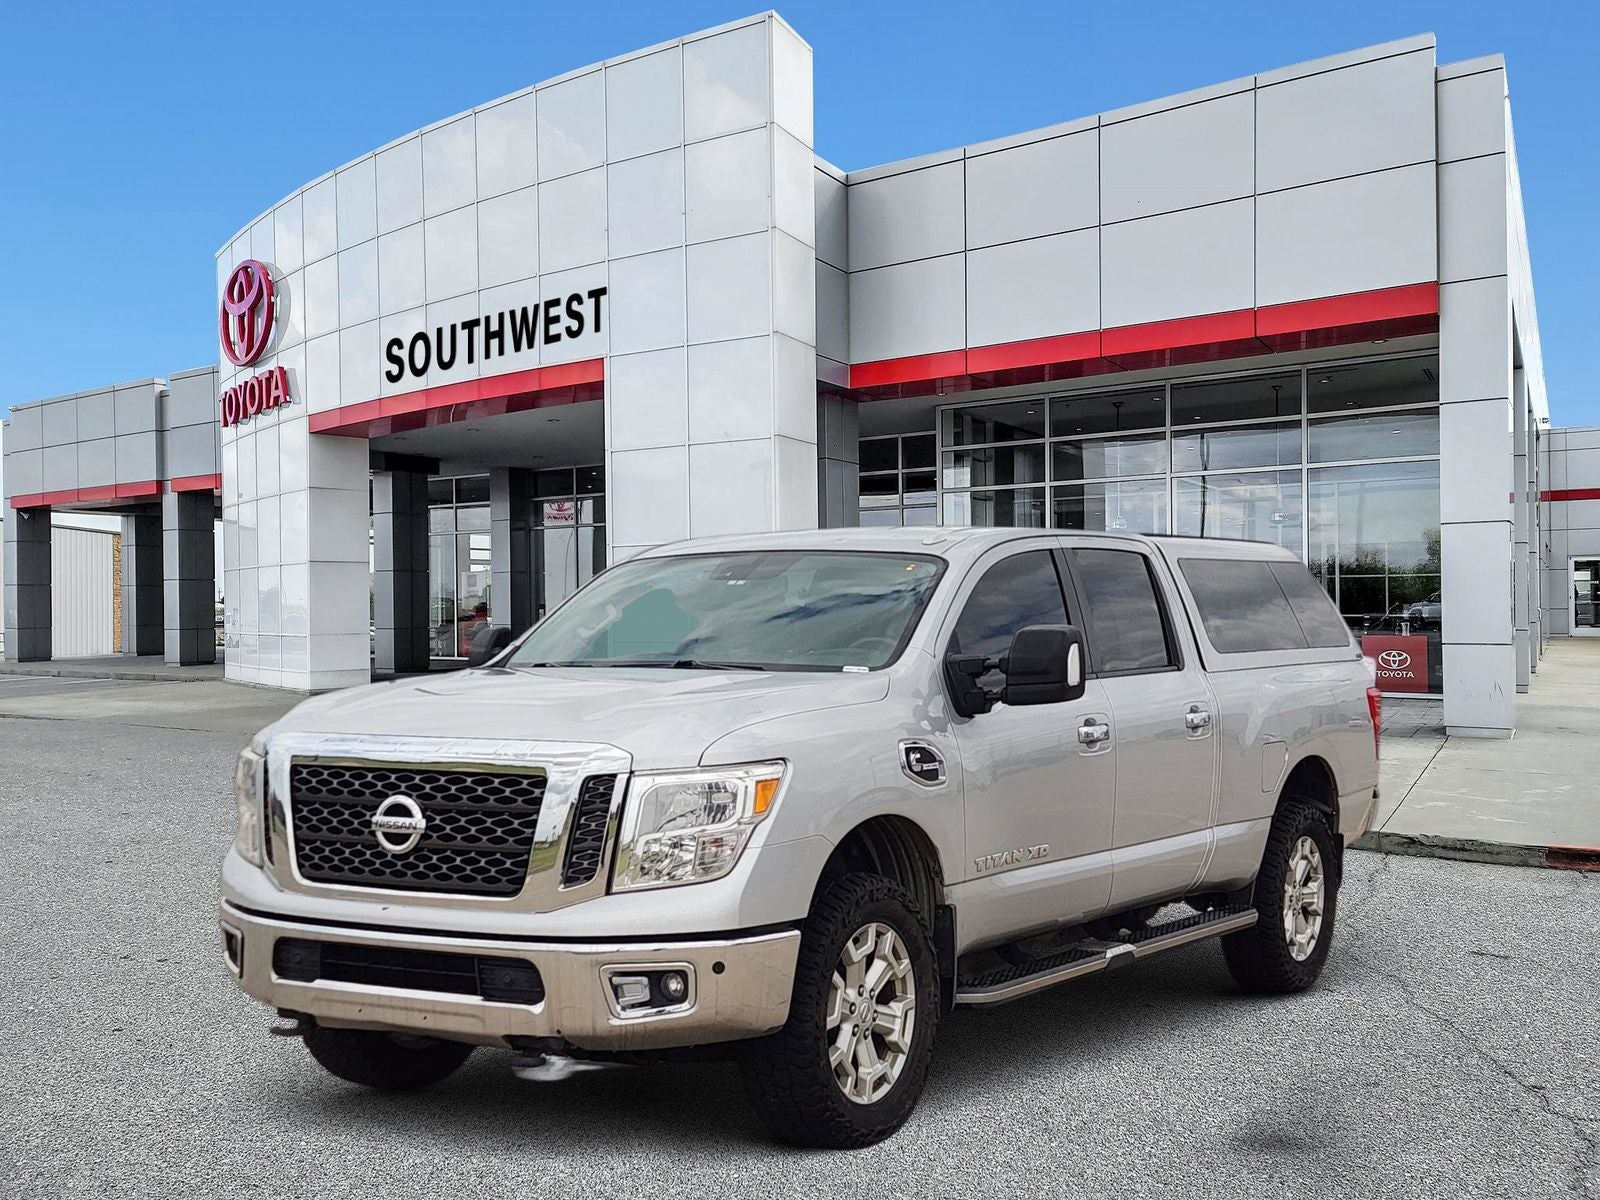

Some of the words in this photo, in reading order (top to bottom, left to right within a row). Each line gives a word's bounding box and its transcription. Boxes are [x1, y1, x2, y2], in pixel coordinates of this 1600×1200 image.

[385, 286, 608, 384] SOUTHWEST
[219, 366, 291, 428] TOYOTA
[1376, 670, 1415, 678] TOYOTA
[374, 819, 419, 830] NISSAN
[975, 848, 1024, 872] TITAN
[1027, 844, 1049, 860] XD
